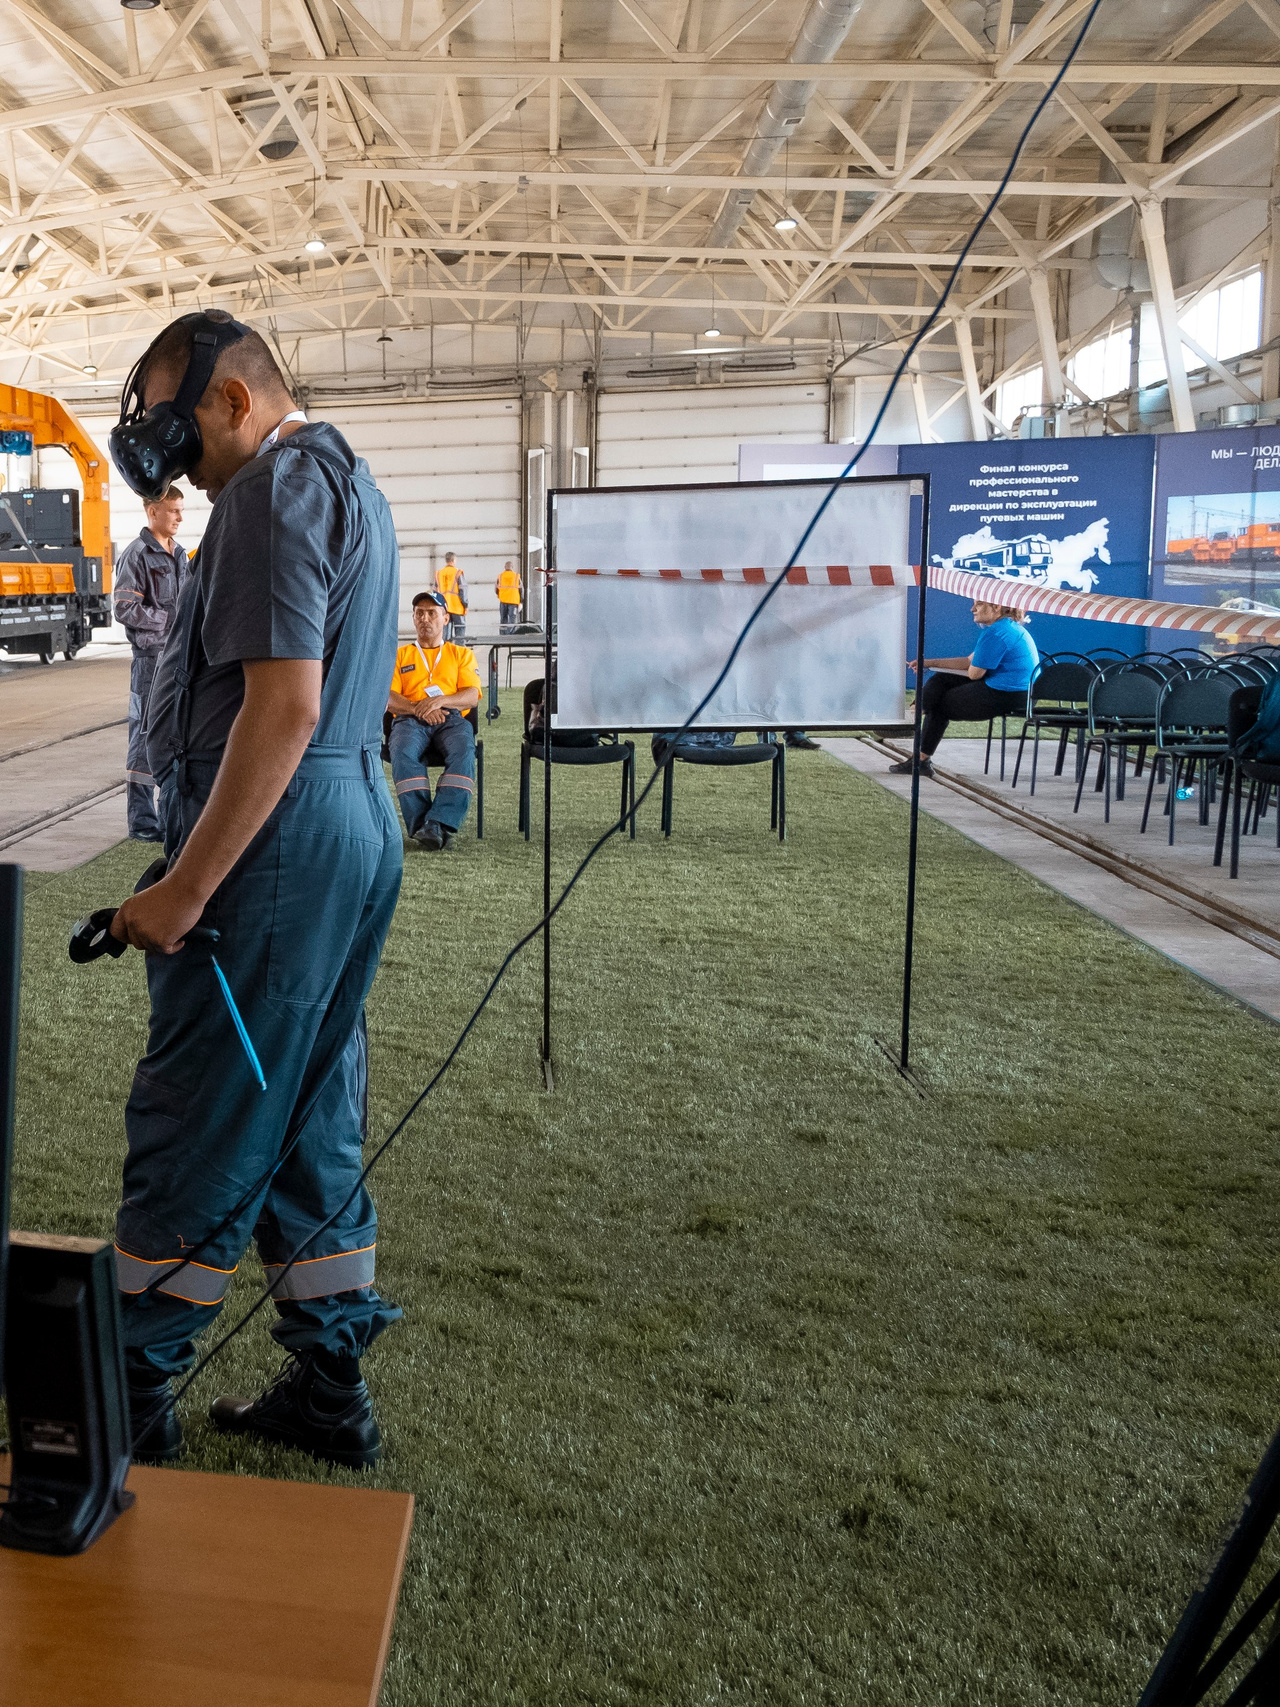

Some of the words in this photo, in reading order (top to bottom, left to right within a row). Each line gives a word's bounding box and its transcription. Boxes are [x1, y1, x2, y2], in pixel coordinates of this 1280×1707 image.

[165, 419, 180, 440] VIVE
[1211, 448, 1233, 459] МЫ
[980, 465, 1016, 474] Финал
[1018, 463, 1069, 473] конкурса
[1254, 457, 1280, 470] ДЕЛ
[969, 475, 1079, 487] профессионального
[988, 489, 1050, 498] мастерства
[1051, 488, 1059, 496] в
[949, 502, 1003, 512] дирекции
[1005, 502, 1019, 510] по
[1021, 500, 1098, 510] эксплуатации
[980, 514, 1025, 524] путевых
[1027, 513, 1065, 521] машин
